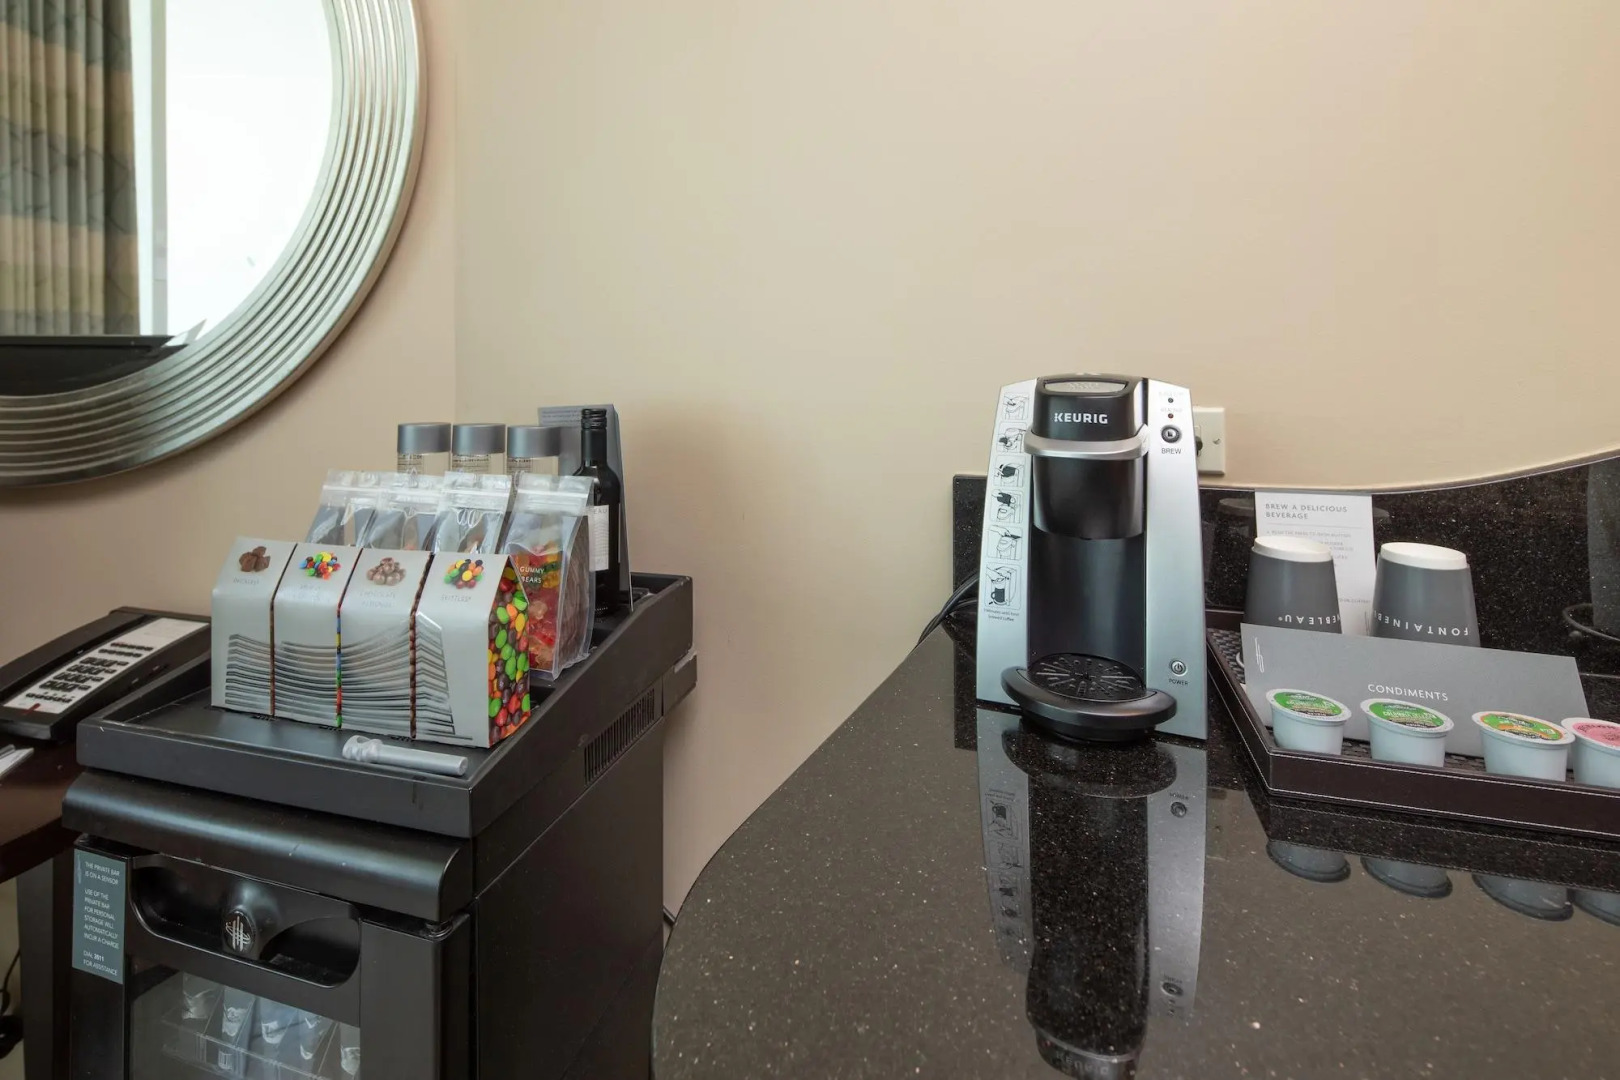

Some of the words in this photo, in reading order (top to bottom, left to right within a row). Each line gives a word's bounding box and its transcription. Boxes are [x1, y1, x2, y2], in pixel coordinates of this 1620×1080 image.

[1054, 412, 1108, 424] KEURIG
[1161, 447, 1182, 455] BREW
[1300, 504, 1348, 513] DELICIOUS
[1265, 511, 1309, 520] BEVERAGE
[519, 566, 544, 574] GUMMY
[521, 576, 541, 584] BEARS
[1168, 678, 1189, 686] POWER
[1367, 683, 1449, 701] CONDIMENTS
